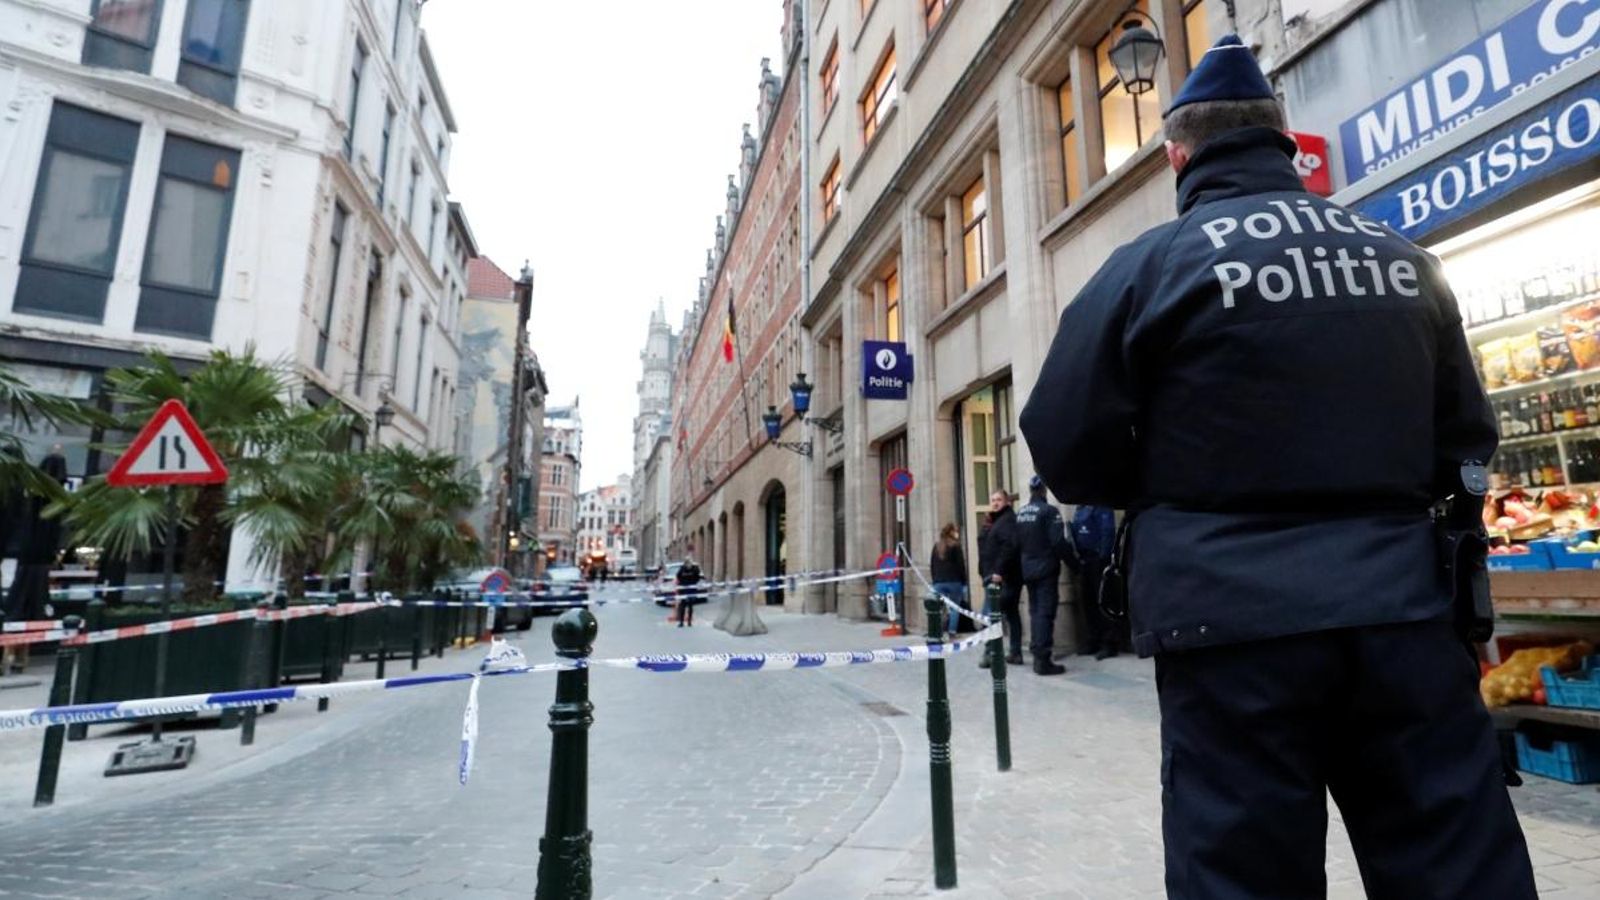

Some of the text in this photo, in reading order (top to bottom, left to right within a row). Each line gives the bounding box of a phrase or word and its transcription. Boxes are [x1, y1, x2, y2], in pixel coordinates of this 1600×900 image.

[1357, 31, 1511, 164] MIDI
[1201, 199, 1387, 249] Police
[1213, 246, 1420, 309] Politie
[869, 375, 903, 388] Politie
